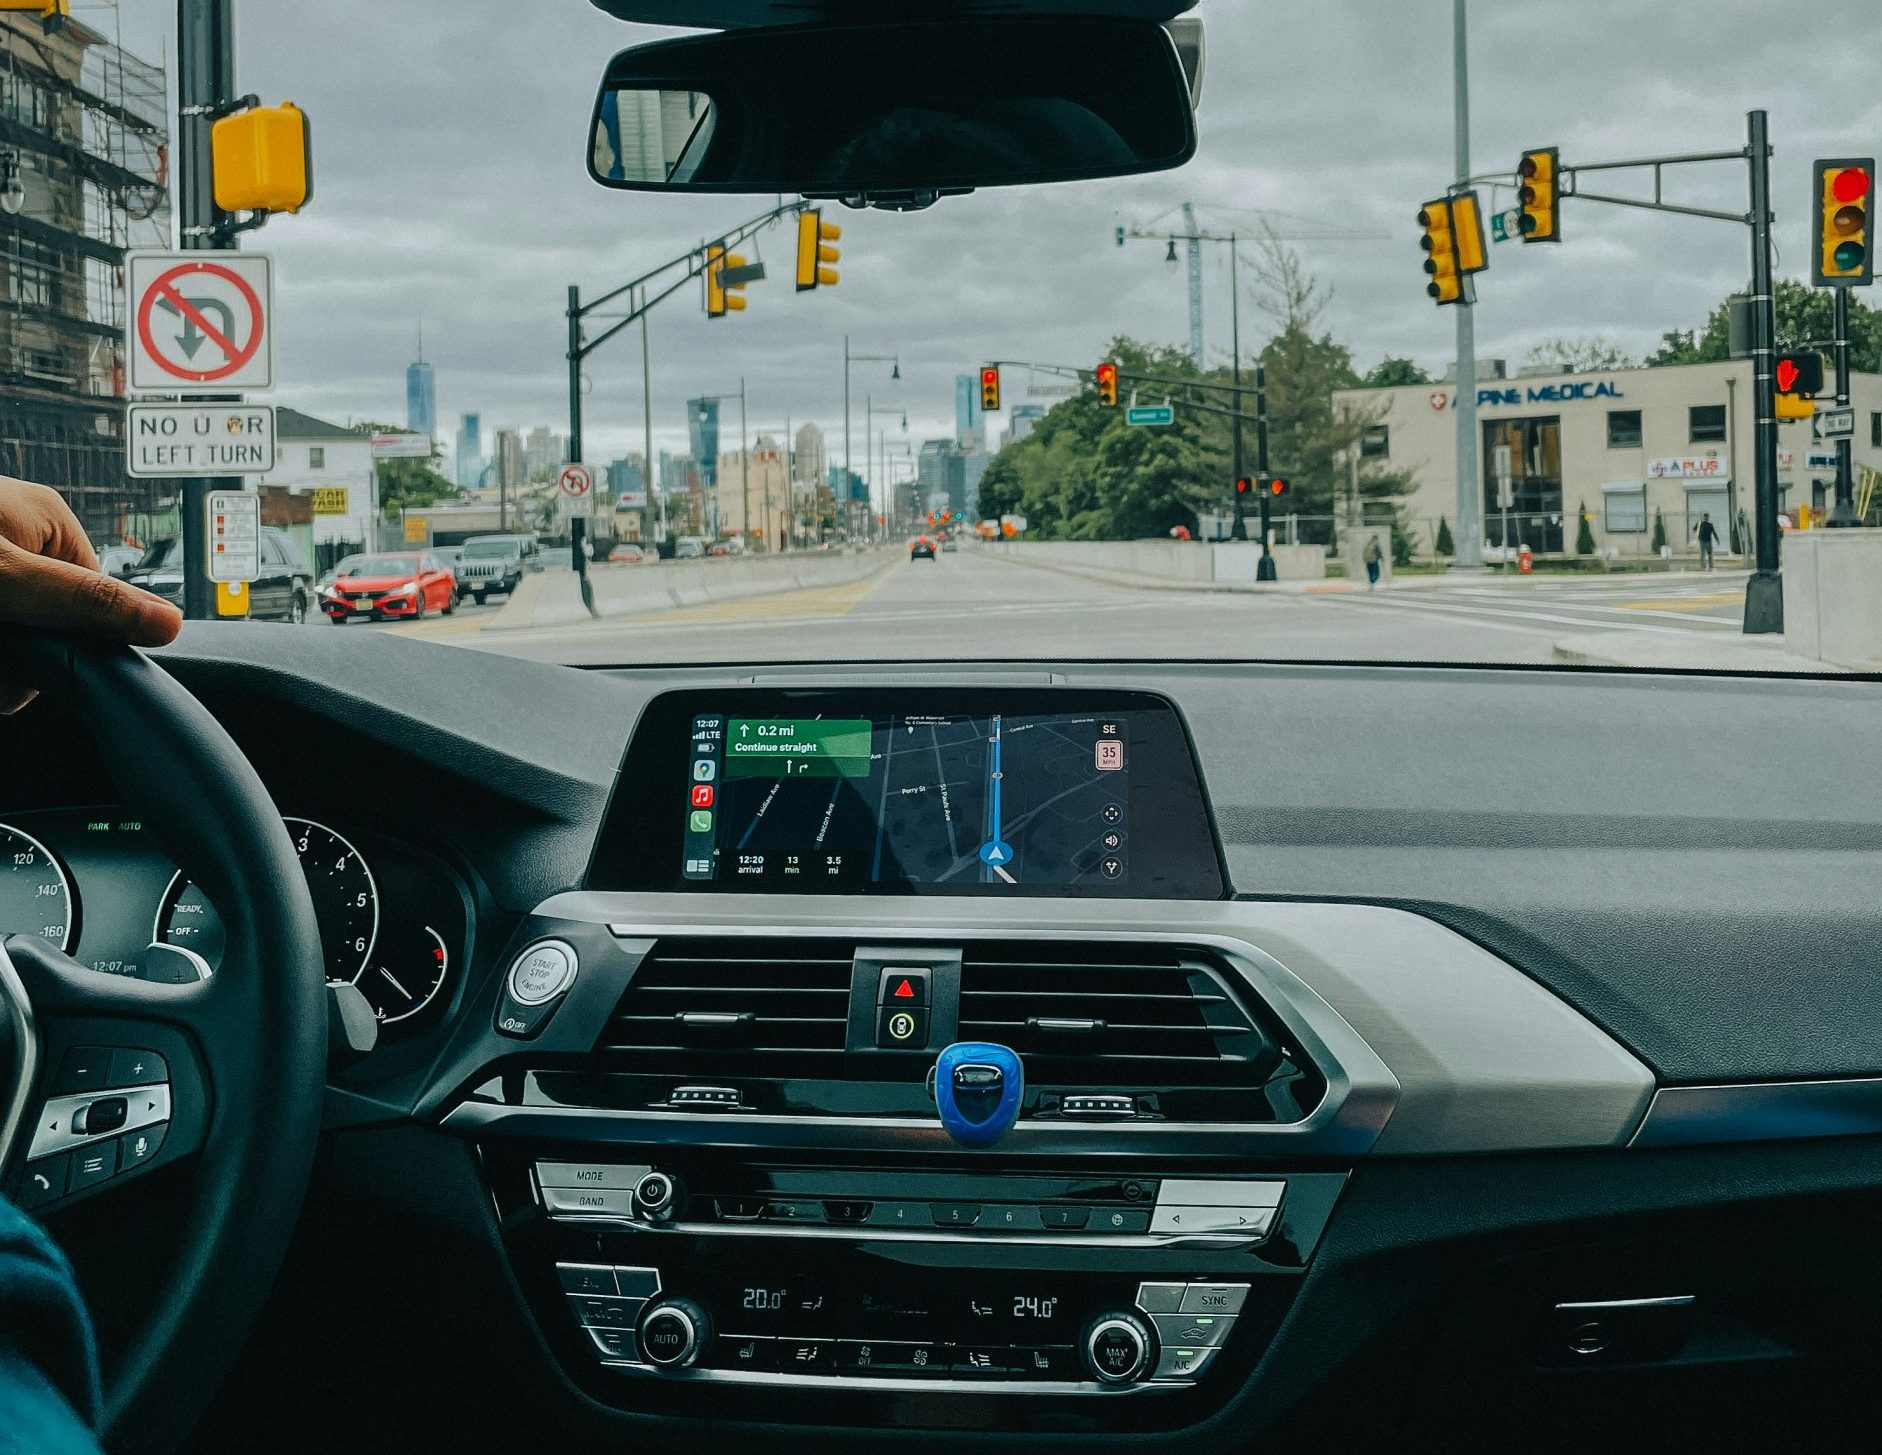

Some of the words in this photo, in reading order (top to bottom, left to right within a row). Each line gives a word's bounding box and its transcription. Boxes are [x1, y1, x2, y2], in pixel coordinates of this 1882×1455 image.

[1452, 388, 1521, 409] PINE
[1527, 381, 1624, 403] MEDICAL
[140, 416, 178, 436] NO
[193, 416, 212, 436] U
[142, 445, 195, 466] LEFT
[208, 444, 263, 465] TURN
[1671, 461, 1680, 472] A
[1683, 459, 1718, 471] PLUS
[696, 720, 719, 728] 12:07
[1102, 724, 1116, 734] SE
[706, 731, 720, 739] LTE
[757, 725, 777, 736] 0.2
[779, 725, 794, 736] mi
[735, 742, 777, 752] Continue
[780, 742, 817, 754] straight
[1102, 747, 1116, 758] 35
[770, 783, 780, 795] Ave
[902, 787, 918, 795] Perry
[88, 822, 109, 831] PARK
[118, 822, 141, 831] AUTO
[816, 816, 830, 842] Beacon
[825, 803, 835, 816] Ave
[298, 838, 308, 852] 3
[13, 853, 34, 865] 120
[336, 857, 346, 871] 4
[739, 856, 764, 864] 12:20
[787, 856, 798, 864] 13
[826, 857, 841, 865] 3.5
[738, 866, 763, 874] arrival
[784, 866, 800, 874] min
[828, 867, 839, 875] mi
[37, 884, 58, 896] 140
[356, 893, 367, 908] 5
[176, 905, 201, 913] READY
[43, 925, 64, 937] 160
[175, 928, 191, 936] OFF
[355, 937, 366, 952] 6
[92, 961, 122, 972] 12:07
[123, 964, 137, 973] pm
[532, 959, 557, 970] START
[529, 969, 550, 979] STOP
[521, 979, 548, 992] ENGINE
[514, 1021, 526, 1030] OFF
[576, 1172, 603, 1181] MODE
[579, 1197, 604, 1206] BAND
[738, 1204, 744, 1214] 1
[788, 1207, 796, 1217] 2
[843, 1207, 851, 1217] 3
[897, 1209, 904, 1219] 4
[952, 1210, 959, 1220] 5
[1006, 1212, 1013, 1222] 6
[1061, 1213, 1069, 1223] 7
[1202, 1296, 1227, 1307] SYNC
[654, 1334, 678, 1345] AUTO
[859, 1357, 872, 1366] OFF
[1109, 1356, 1124, 1366] A/C
[1174, 1361, 1190, 1371] A/C
